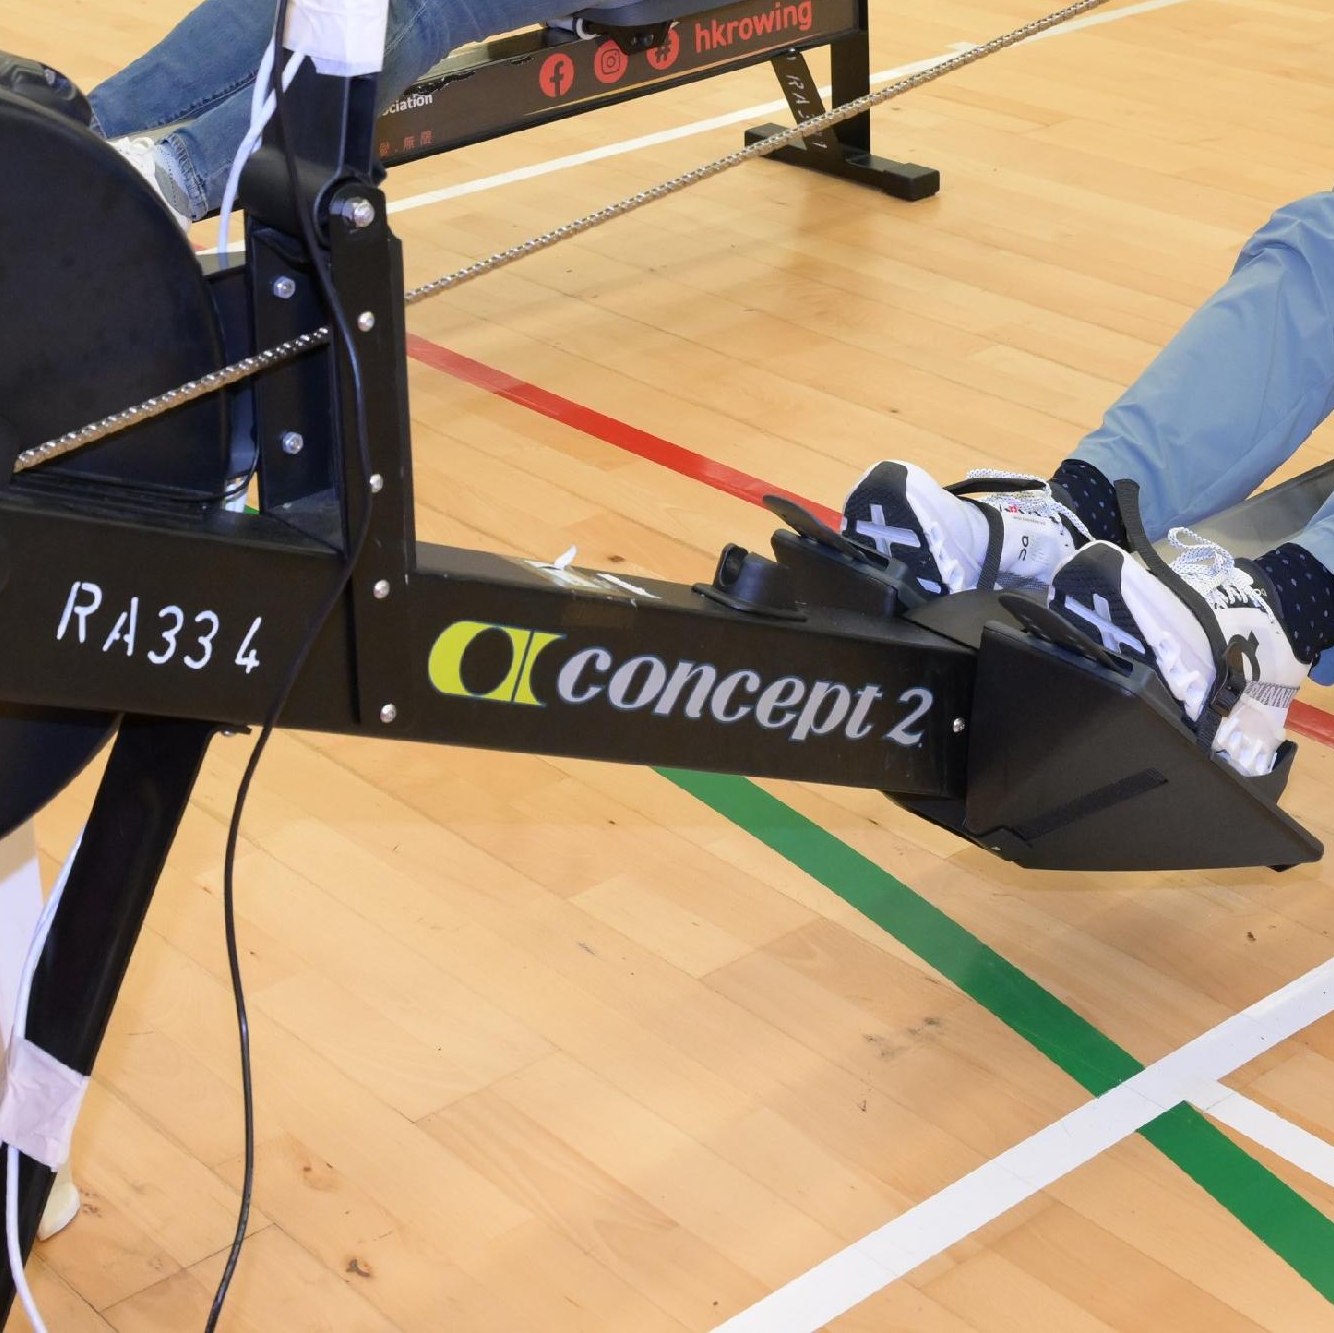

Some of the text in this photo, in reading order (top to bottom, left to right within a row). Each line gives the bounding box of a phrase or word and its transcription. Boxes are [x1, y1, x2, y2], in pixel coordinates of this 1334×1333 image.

[695, 0, 812, 53] hkrowing
[57, 581, 262, 674] RA334
[557, 645, 935, 748] concept 2
